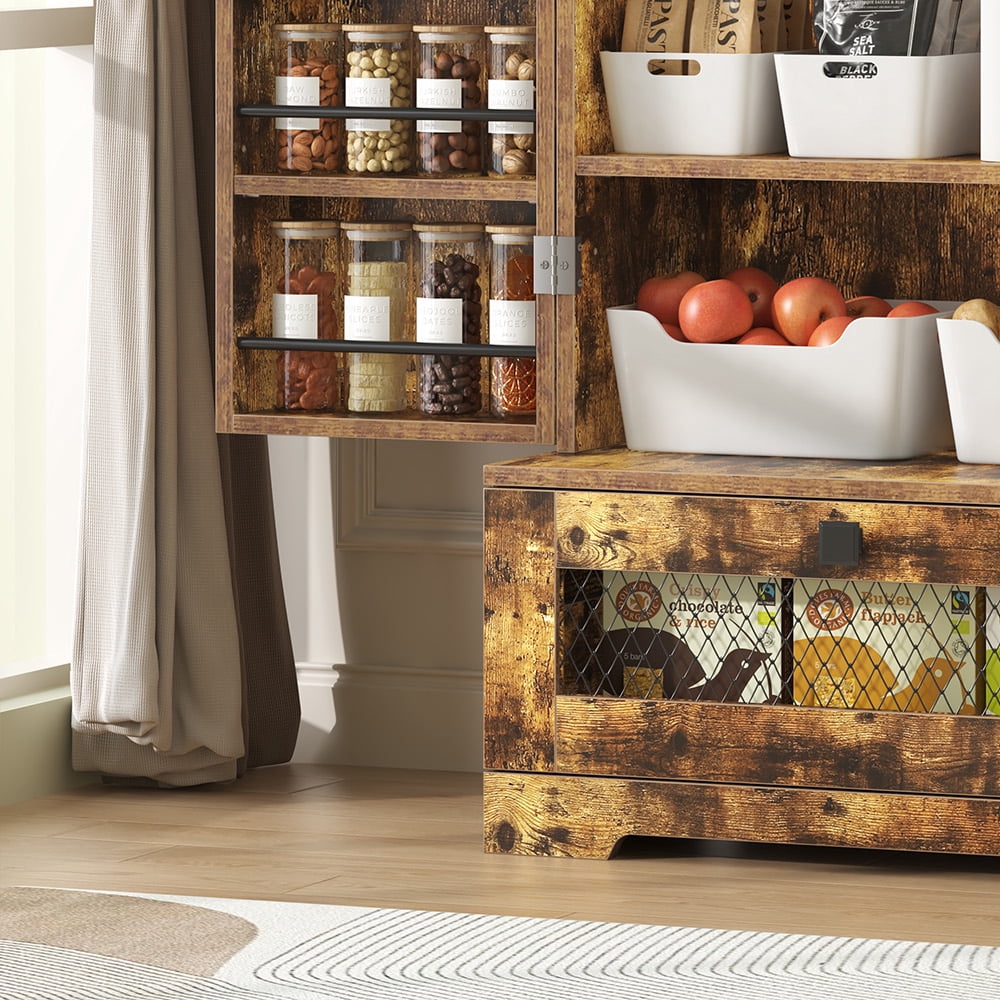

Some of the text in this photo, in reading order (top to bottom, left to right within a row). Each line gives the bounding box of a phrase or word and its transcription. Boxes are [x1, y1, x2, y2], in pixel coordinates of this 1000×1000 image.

[853, 35, 873, 46] SEA
[848, 45, 875, 56] SALT
[840, 64, 877, 75] BLACK
[861, 591, 912, 606] Butter
[669, 600, 743, 614] chocolate
[669, 614, 717, 628] & rice
[861, 609, 926, 626] flapjack
